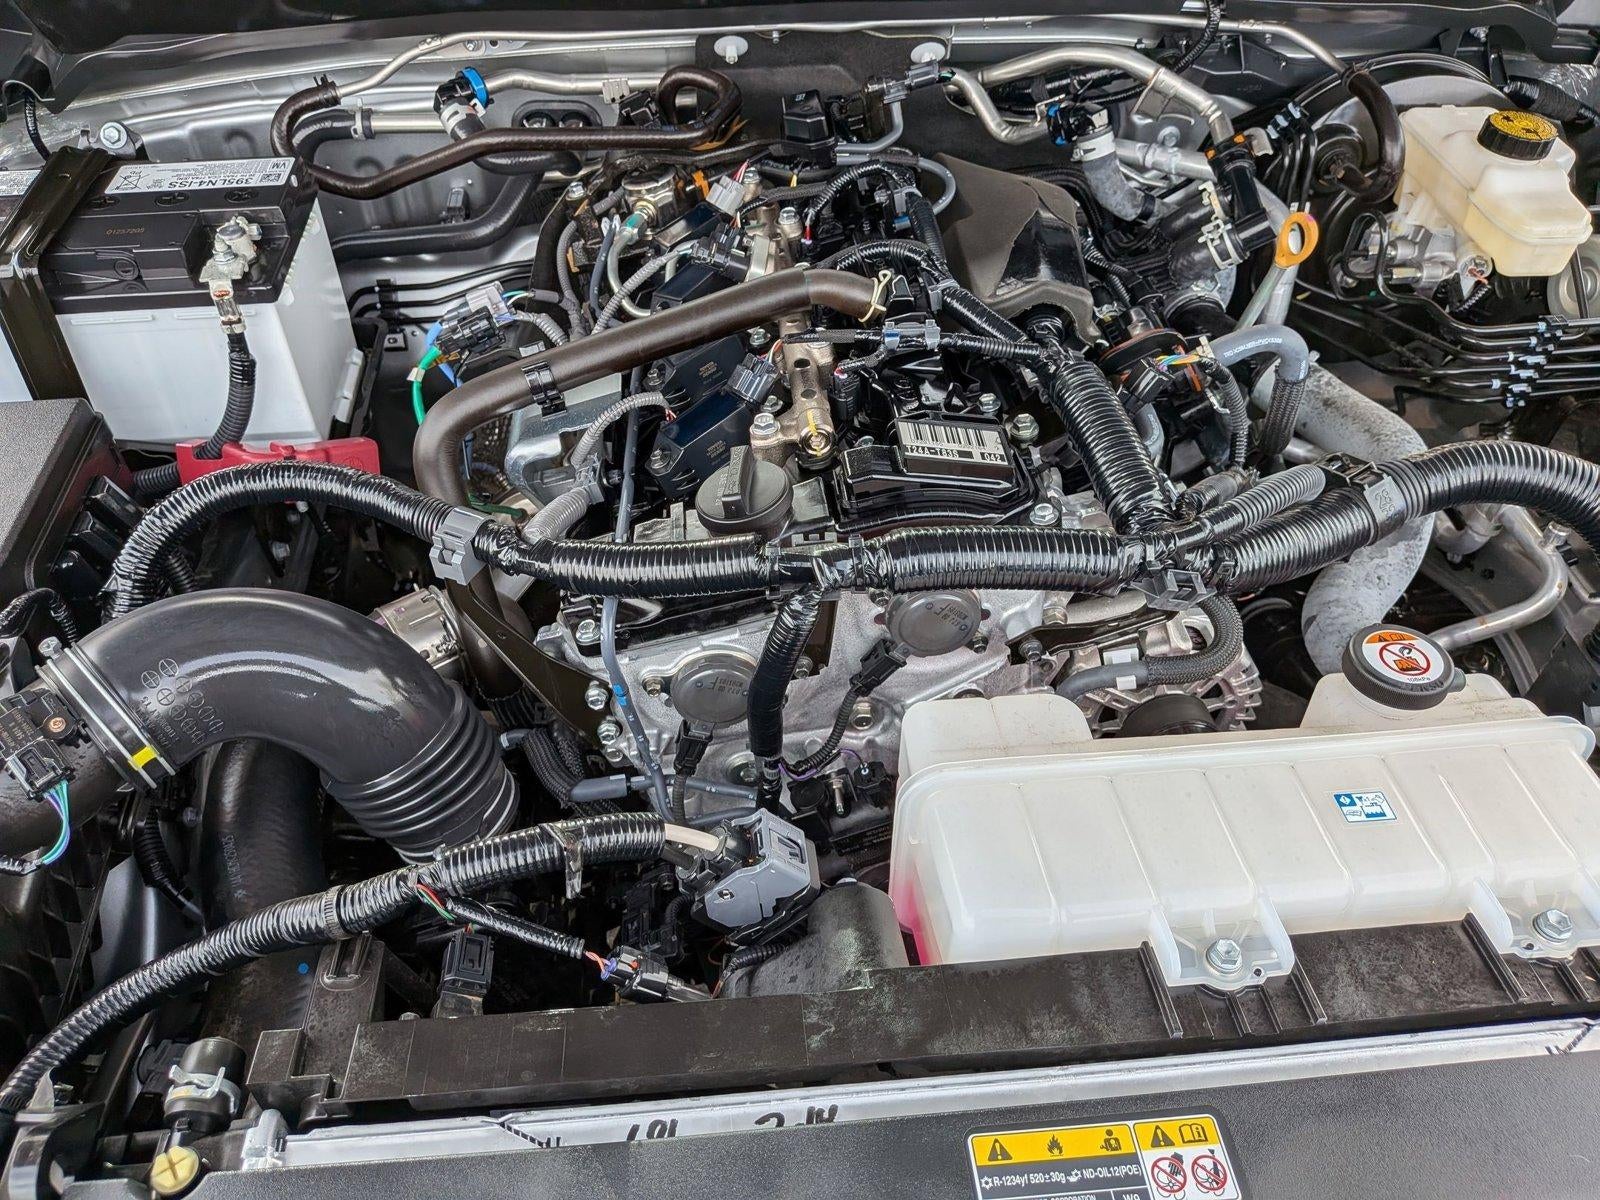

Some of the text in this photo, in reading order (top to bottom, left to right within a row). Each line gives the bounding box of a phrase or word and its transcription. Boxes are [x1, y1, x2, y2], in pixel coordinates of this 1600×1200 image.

[272, 162, 286, 170] VM
[168, 178, 253, 189] 395LN4-ISS
[993, 1164, 1142, 1188] R-1234yf 520±30g ND-OIL12(POE)
